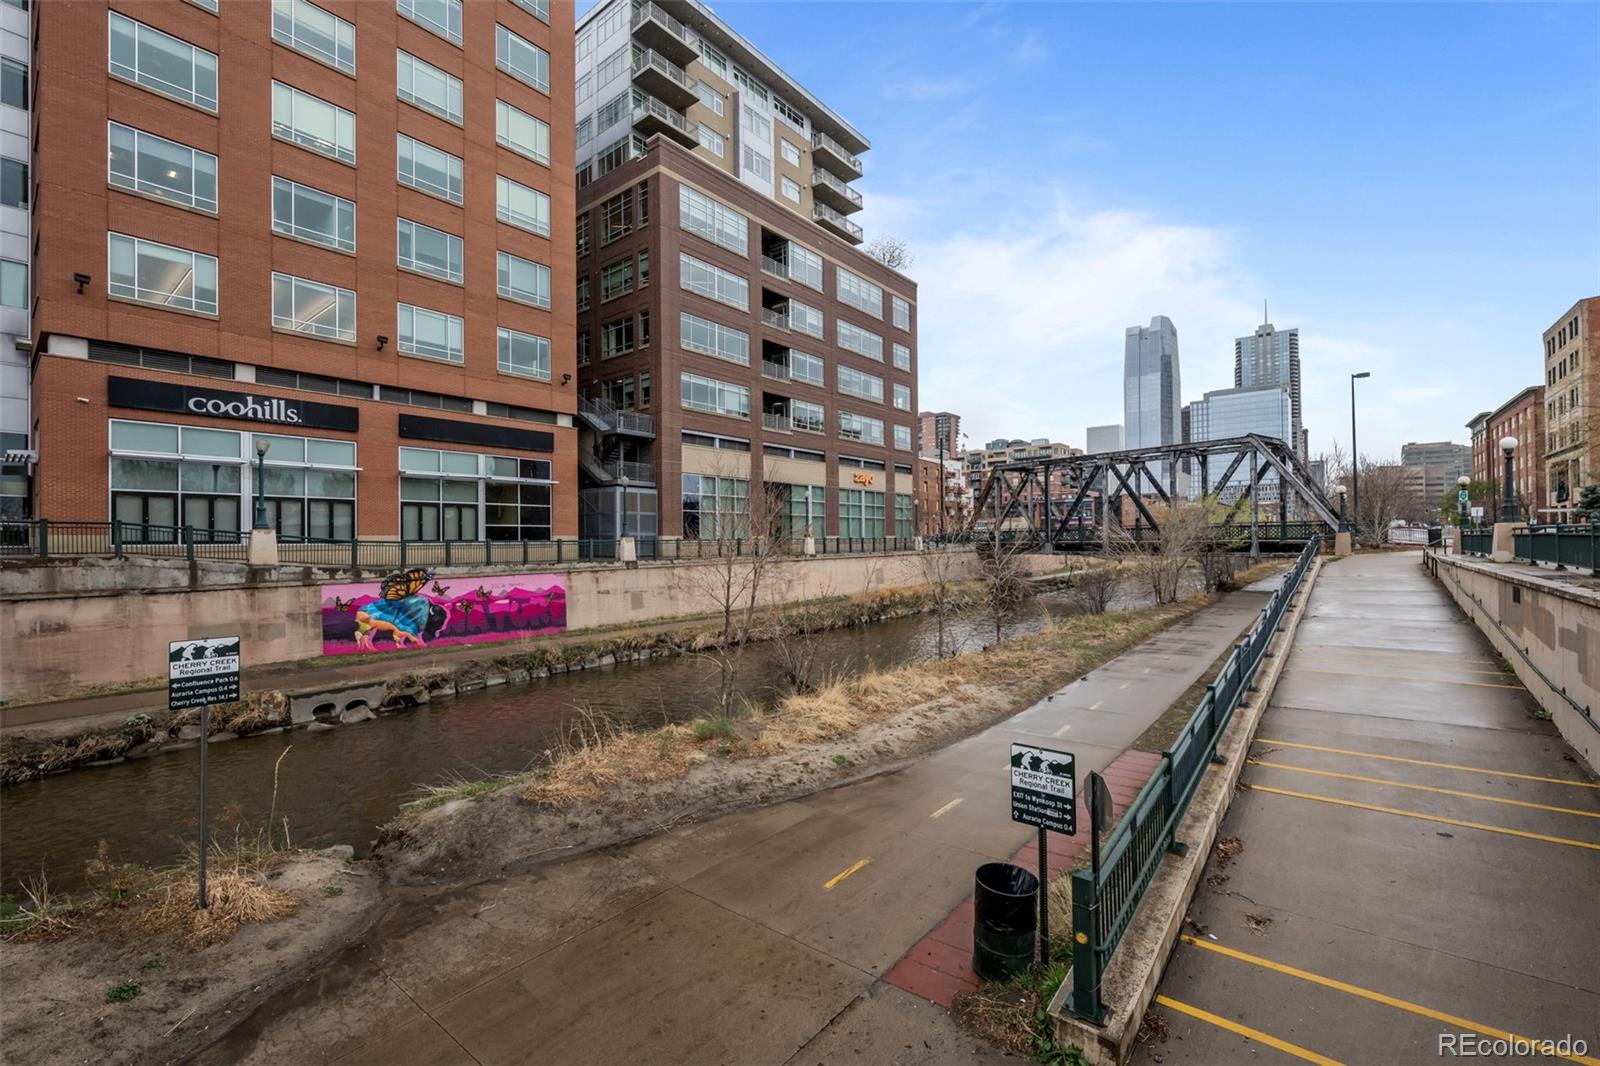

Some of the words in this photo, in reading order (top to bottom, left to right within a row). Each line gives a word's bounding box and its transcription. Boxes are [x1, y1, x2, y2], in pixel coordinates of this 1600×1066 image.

[172, 661, 207, 670] CHERRY
[210, 658, 237, 666] CREEK
[179, 667, 213, 675] Regional
[181, 679, 214, 688] Confluence
[171, 690, 193, 698] Auraria
[195, 687, 217, 695] Campus
[171, 699, 189, 707] Cherry
[1014, 770, 1044, 781] CHERRY
[1045, 777, 1071, 788] CREEK
[1020, 778, 1048, 790] Regional
[1050, 785, 1065, 794] Trail
[1013, 791, 1024, 799] EXIT
[1031, 795, 1056, 807] Wynkoop
[1013, 801, 1028, 810] Union
[1023, 813, 1041, 823] Auraria
[1042, 818, 1063, 829] Campus
